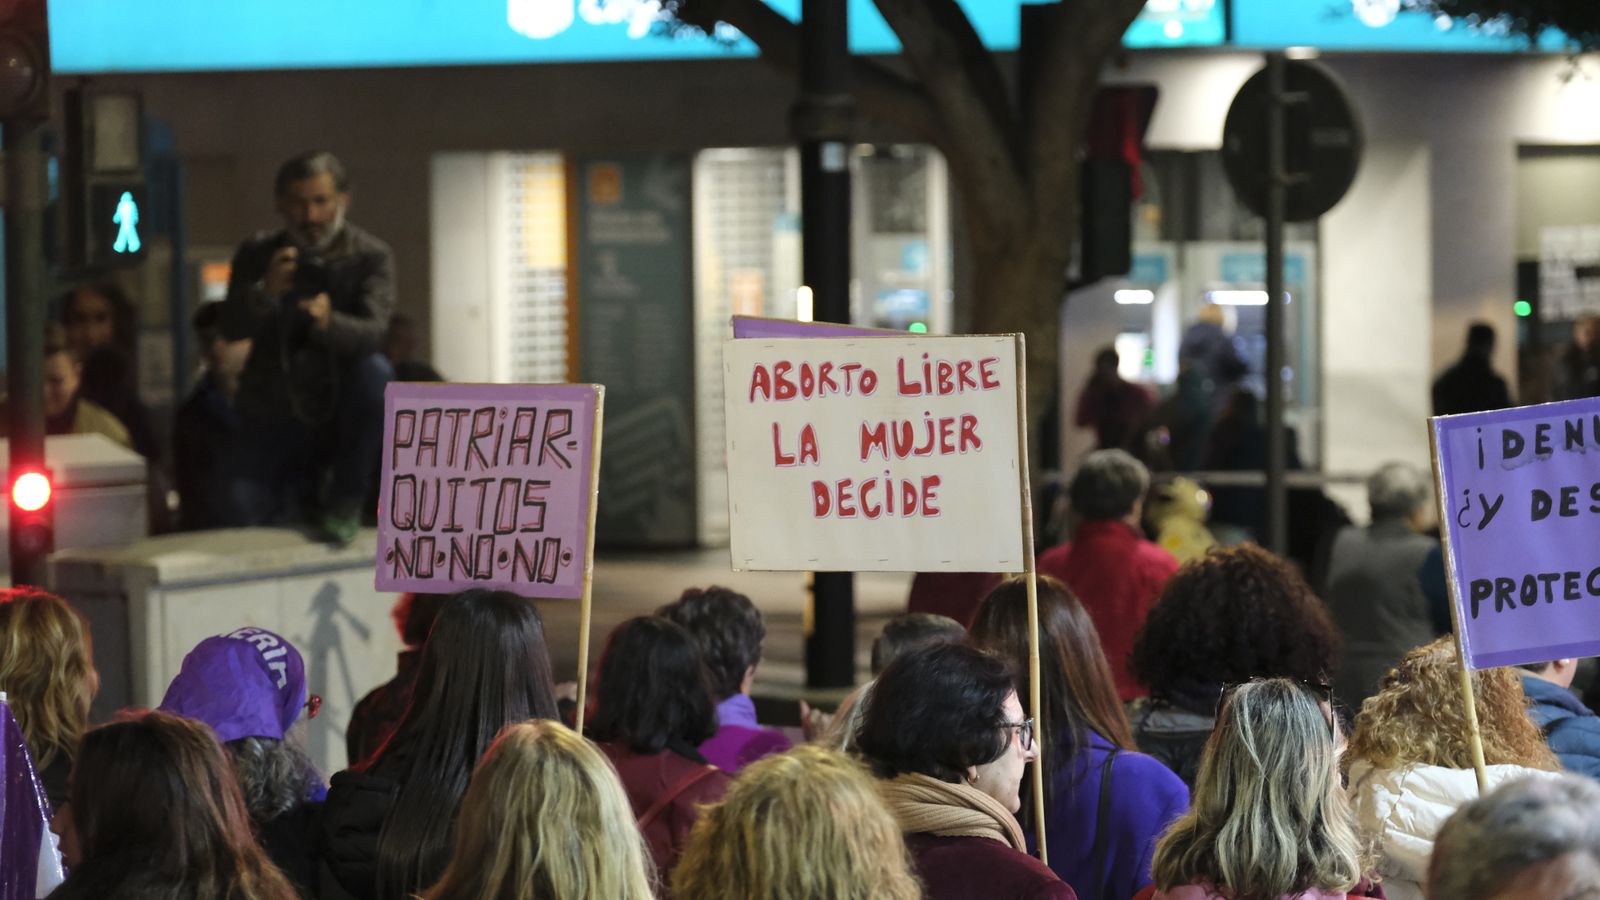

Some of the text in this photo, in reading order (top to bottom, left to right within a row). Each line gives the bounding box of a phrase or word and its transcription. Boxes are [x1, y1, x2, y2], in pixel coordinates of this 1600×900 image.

[750, 352, 1001, 403] ABORTO LIBRE
[772, 410, 984, 467] LA MUJER
[391, 473, 551, 536] QUITOS
[811, 469, 943, 520] DECIDE
